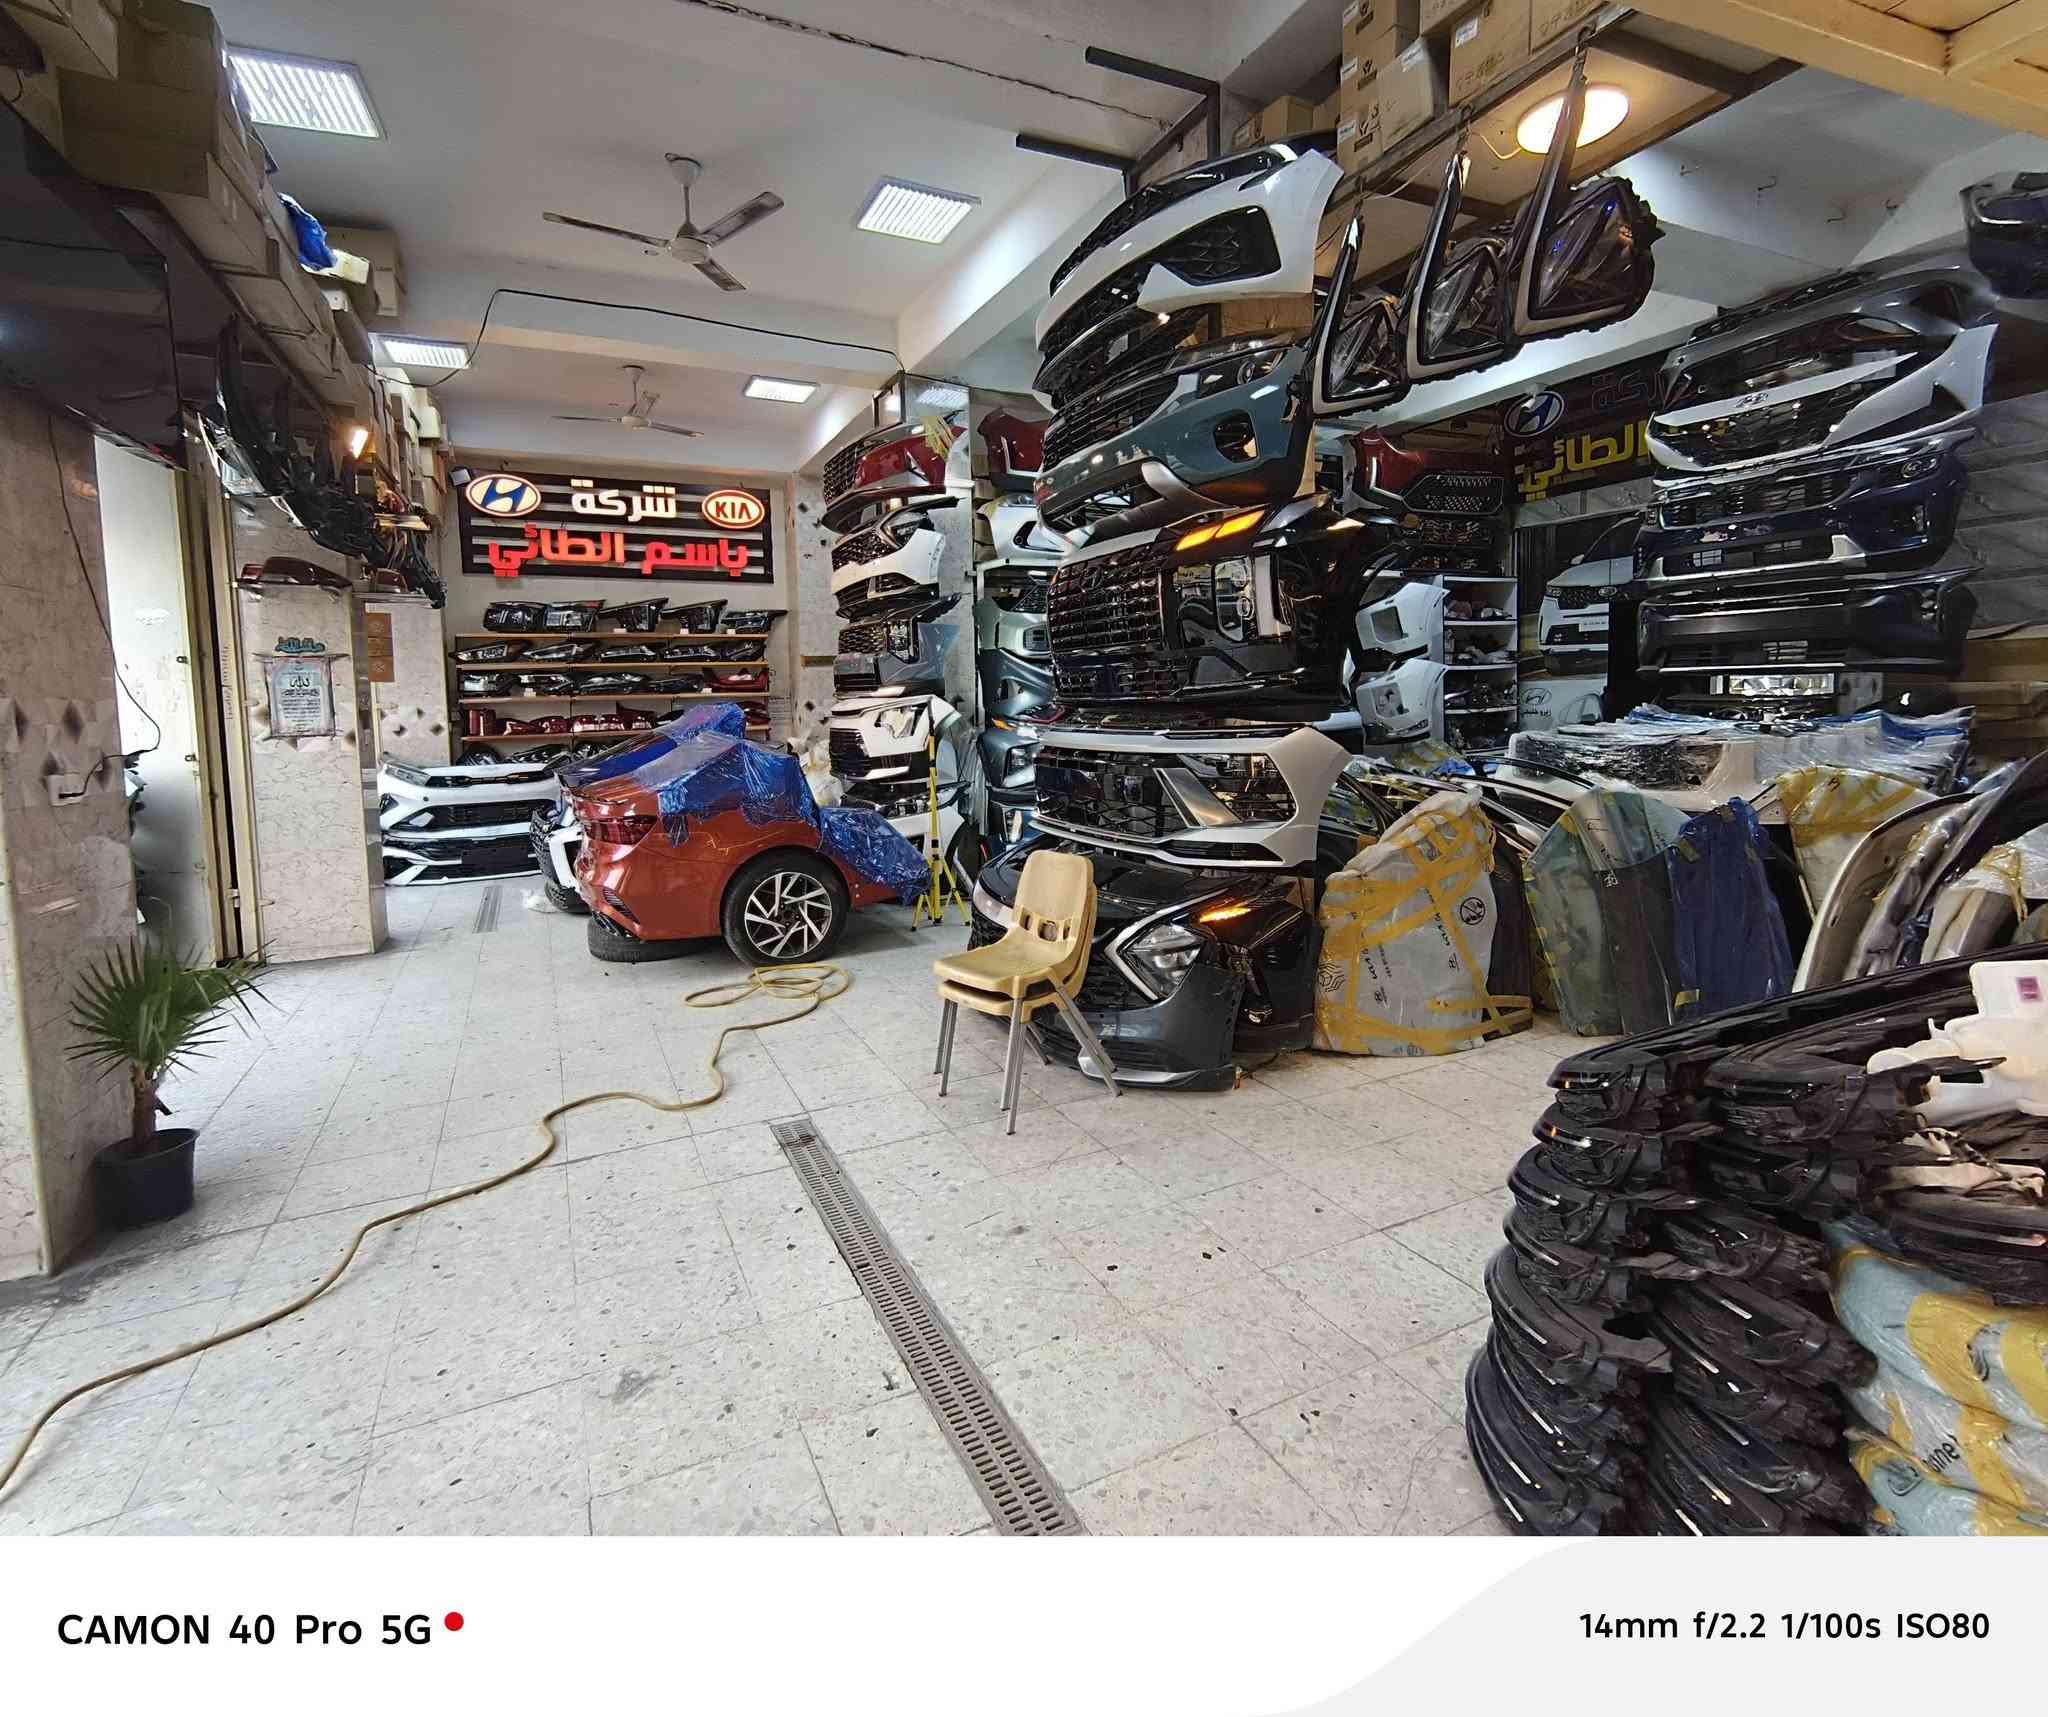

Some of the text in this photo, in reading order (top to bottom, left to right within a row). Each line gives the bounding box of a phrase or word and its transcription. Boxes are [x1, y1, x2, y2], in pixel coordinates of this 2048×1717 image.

[570, 479, 677, 522] شركة
[714, 501, 752, 520] KIA
[488, 522, 749, 577] باسم الطائي
